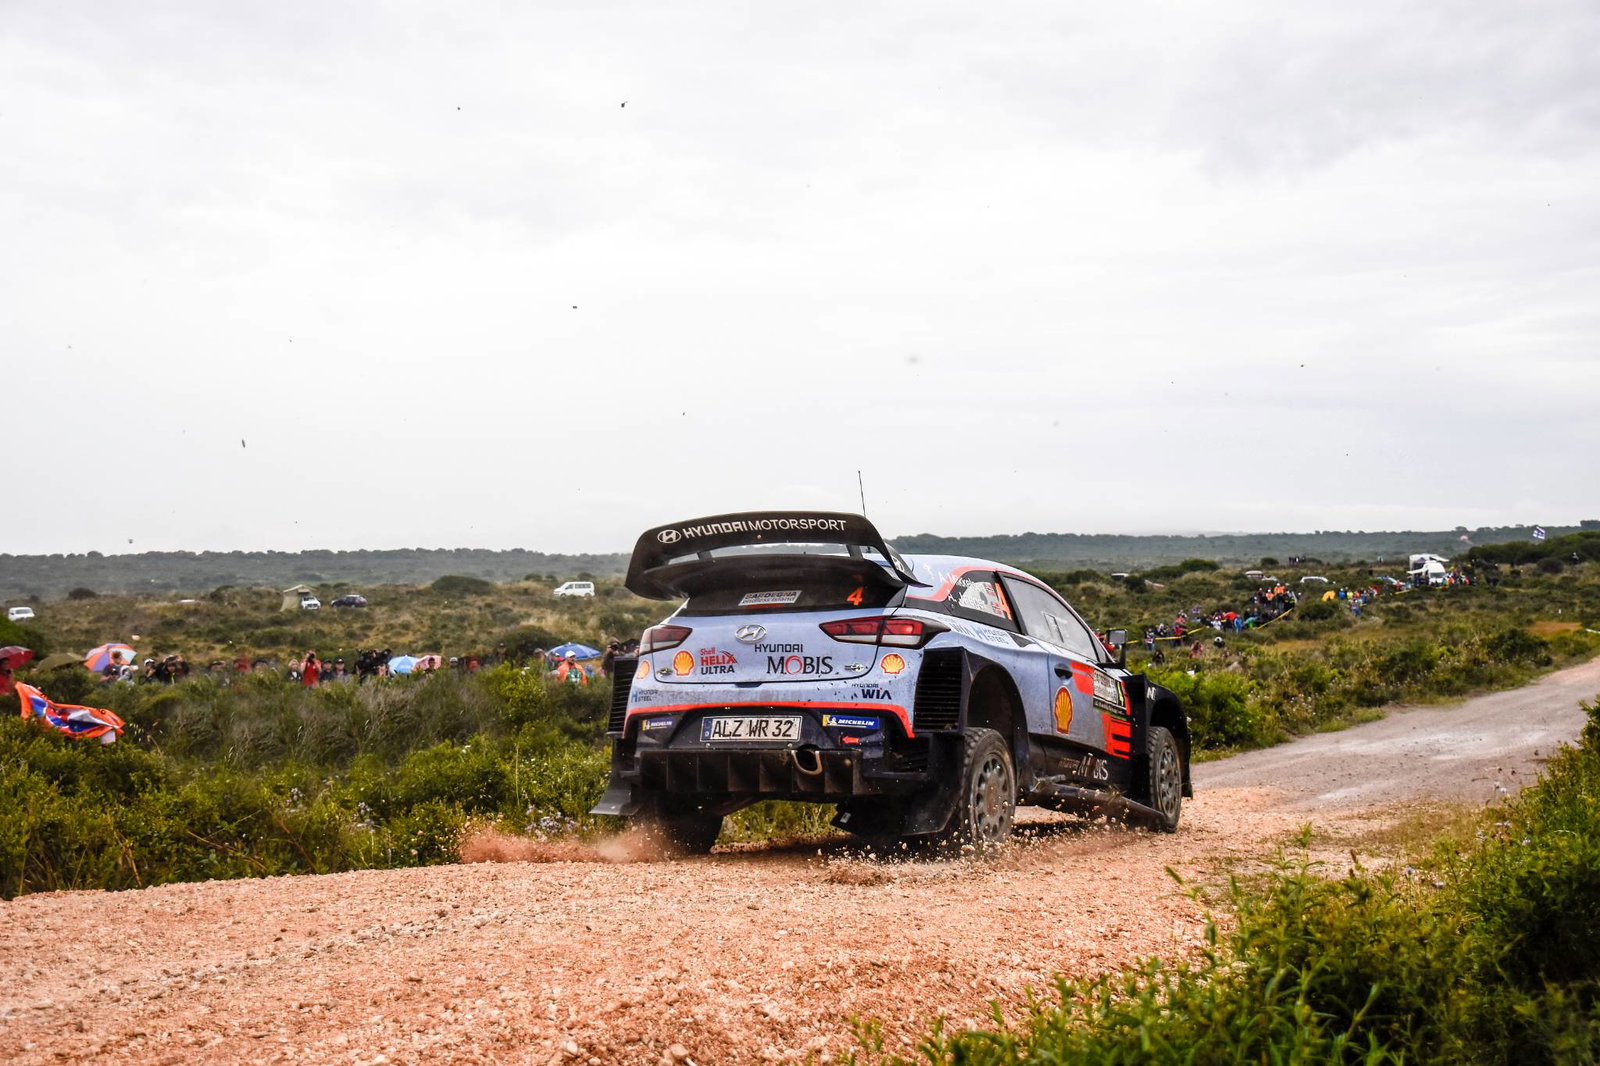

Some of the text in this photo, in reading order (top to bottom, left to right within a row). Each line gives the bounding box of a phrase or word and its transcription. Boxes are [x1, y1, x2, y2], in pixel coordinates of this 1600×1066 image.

[682, 518, 847, 539] HYUNDAI MOTORSPORT
[846, 586, 863, 606] 4
[700, 646, 716, 655] Shell
[754, 643, 804, 653] HYUNDAI
[700, 650, 738, 666] HELIX
[766, 655, 834, 675] MOBIS
[701, 665, 735, 675] ULTRA
[861, 687, 892, 700] WIA
[712, 719, 794, 738] ALZ WR 32
